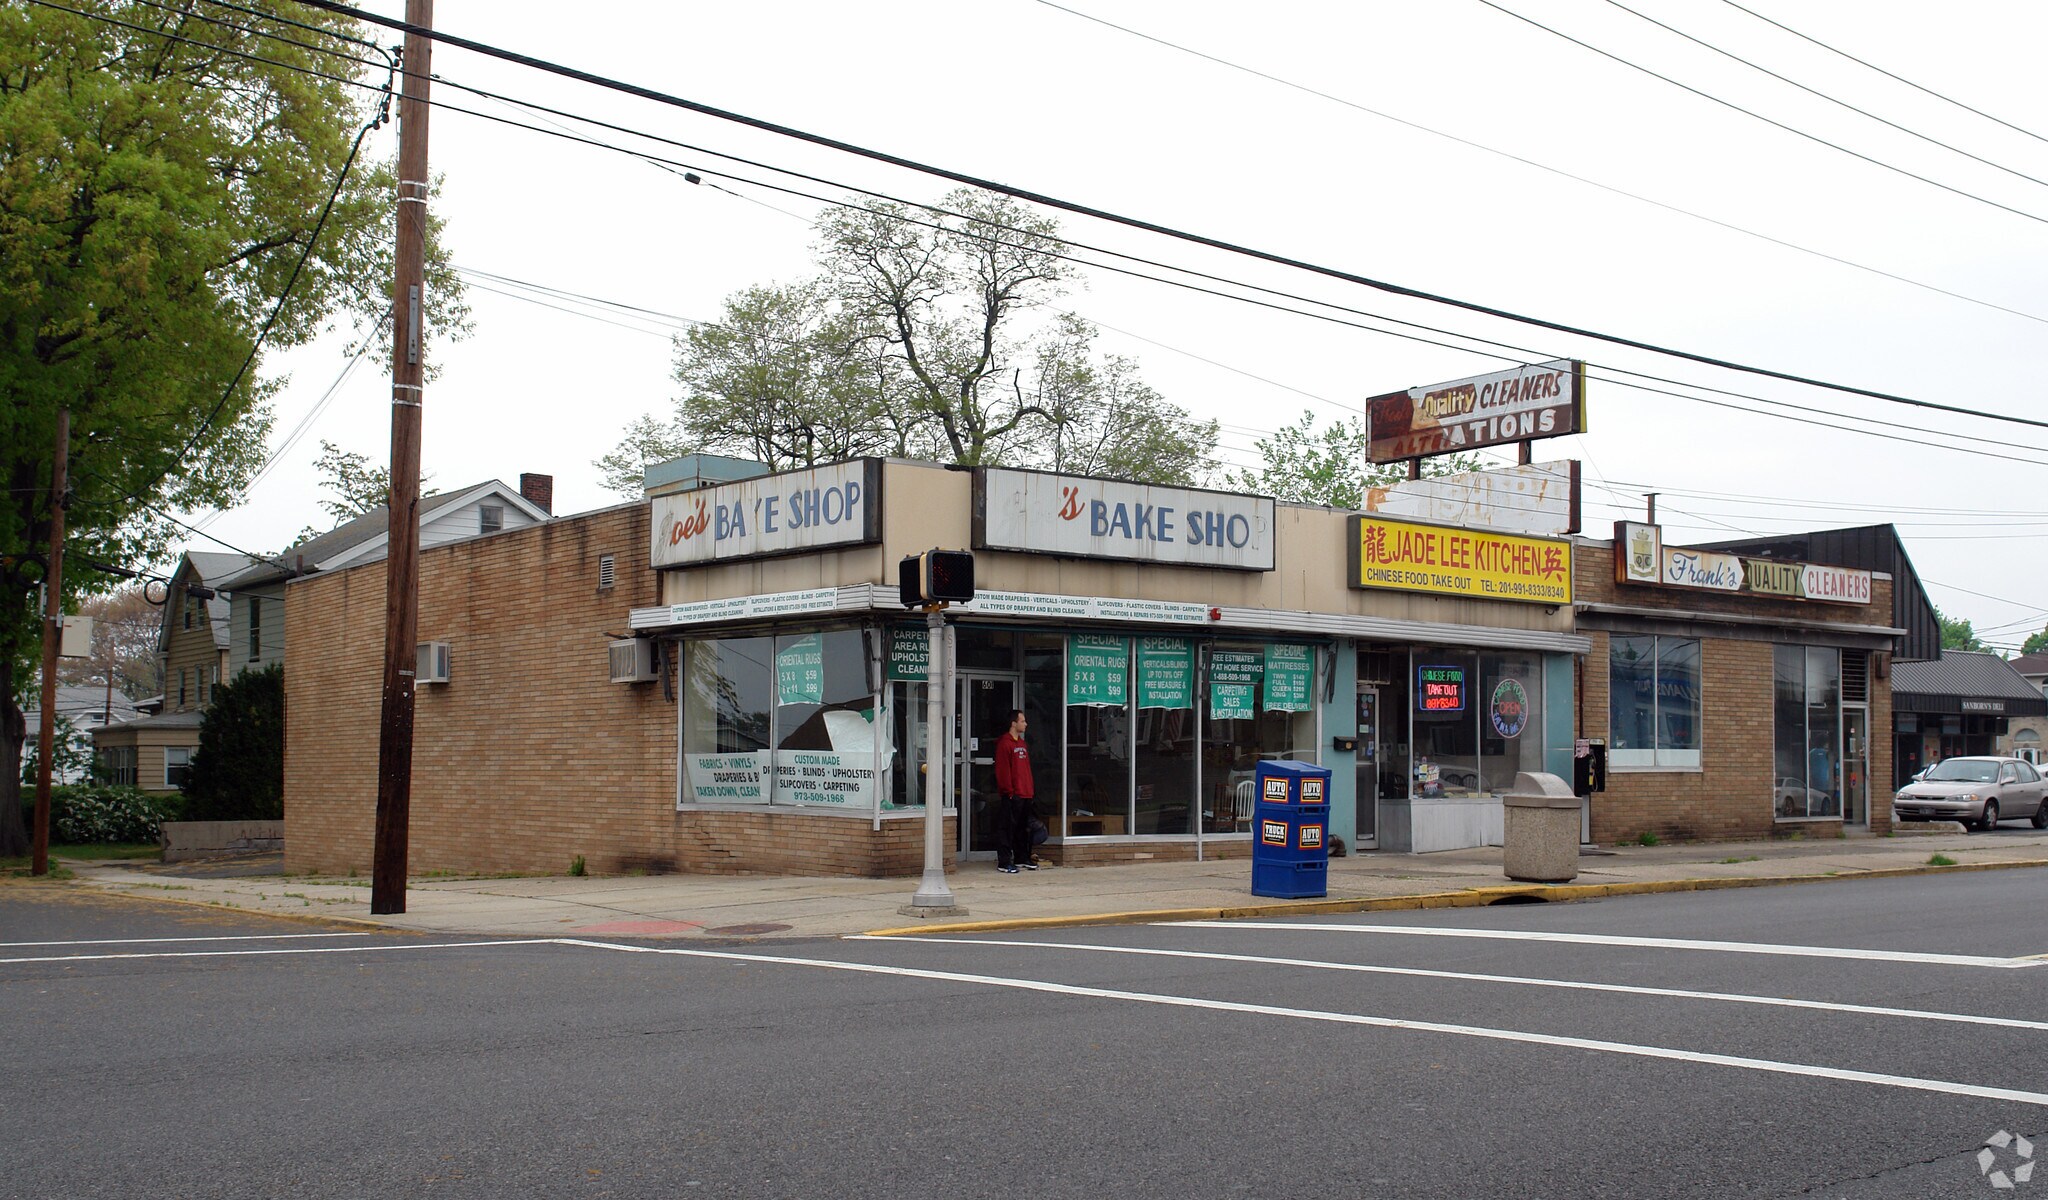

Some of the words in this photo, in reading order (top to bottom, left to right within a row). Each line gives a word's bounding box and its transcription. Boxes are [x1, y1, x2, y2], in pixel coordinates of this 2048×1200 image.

[1425, 389, 1476, 417] Quality
[1480, 372, 1563, 409] CLEANERS
[788, 481, 861, 530] SHOP
[1091, 499, 1174, 543] BAKE
[1363, 525, 1392, 564] 龍
[1392, 531, 1436, 566] JADE
[1441, 536, 1470, 570] LEE
[1475, 540, 1541, 576] KITCHEN
[1542, 546, 1567, 583] 英
[1669, 553, 1737, 588] Frank's
[1808, 571, 1868, 599] CLEANERS
[1367, 568, 1403, 583] CHINESE
[1405, 572, 1429, 586] FOOD
[1431, 574, 1452, 588] TAKE
[1454, 577, 1471, 590] OUT
[1481, 579, 1498, 593] TEL:
[1499, 582, 1565, 599] 201-991-8333/8340
[1005, 594, 1030, 603] DRAPERIES
[1100, 609, 1129, 617] INSTALLATIONS
[1078, 635, 1122, 646] SPECIAL
[1144, 637, 1187, 650] SPECIAL
[895, 642, 918, 651] AREA
[1274, 645, 1306, 657] SPECIAL
[805, 653, 821, 665] RUGS
[1075, 655, 1106, 668] ORIENTAL
[1108, 657, 1126, 668] RUGS
[1225, 655, 1254, 663] ESTIMATES
[1268, 662, 1310, 671] MATTRESSES
[1075, 672, 1080, 680] 5
[1082, 672, 1088, 681] X
[1090, 673, 1095, 681] 8
[1108, 673, 1121, 683] $59
[1173, 671, 1183, 679] OFF
[1422, 670, 1446, 681] CHINESE
[1073, 685, 1078, 693] 8
[1089, 685, 1097, 694] 11
[1108, 685, 1121, 696] $99
[1158, 681, 1181, 689] MEASURE
[1217, 686, 1247, 695] CARPETING
[1149, 691, 1182, 699] INSTALLATION
[1223, 698, 1240, 707] SALES
[1217, 709, 1253, 719] INSTALLATION
[1499, 702, 1521, 715] OPEN
[699, 758, 723, 769] FABRICS
[728, 758, 751, 768] VINYLS
[795, 755, 820, 765] CUSTOM
[822, 756, 840, 765] MADE
[714, 771, 746, 783] DRAPERIES
[748, 772, 753, 782] &
[803, 767, 825, 777] BLINDS
[833, 769, 875, 779] UPHOLSTERY
[779, 780, 816, 790] SLIPCOVERS
[823, 782, 860, 792] CARPETING
[1268, 782, 1285, 791] AUTO
[1304, 783, 1320, 792] AUTO
[696, 786, 715, 797] TAKEN
[717, 786, 740, 798] DOWN,
[794, 791, 844, 803] 973-509-1968
[1266, 825, 1284, 834] TRUCK
[1303, 830, 1319, 838] AUTO
